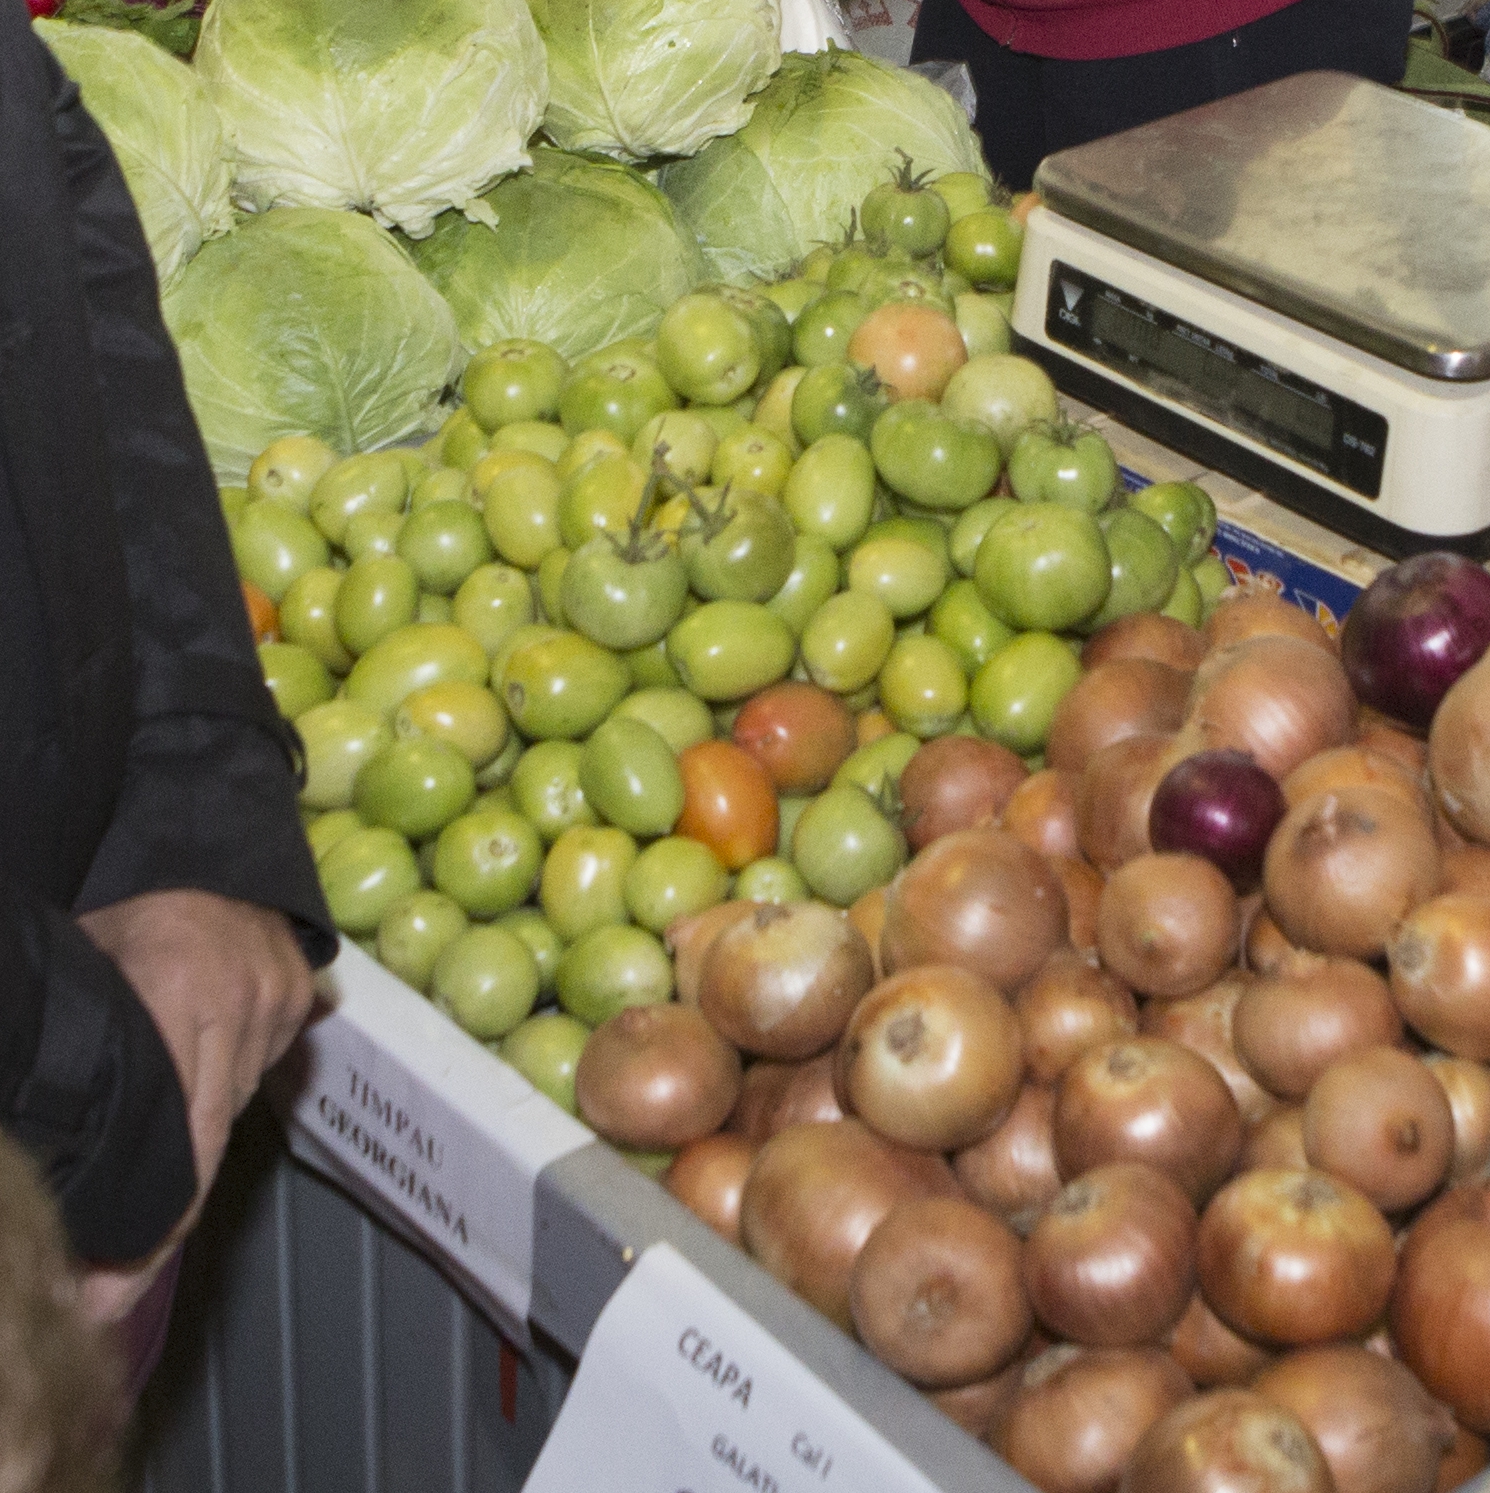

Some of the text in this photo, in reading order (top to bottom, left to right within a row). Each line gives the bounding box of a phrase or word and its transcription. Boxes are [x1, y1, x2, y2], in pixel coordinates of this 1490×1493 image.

[317, 1094, 469, 1245] GEORGIANA
[347, 1063, 444, 1170] TIMPAU
[677, 1326, 757, 1411] CEAPA
